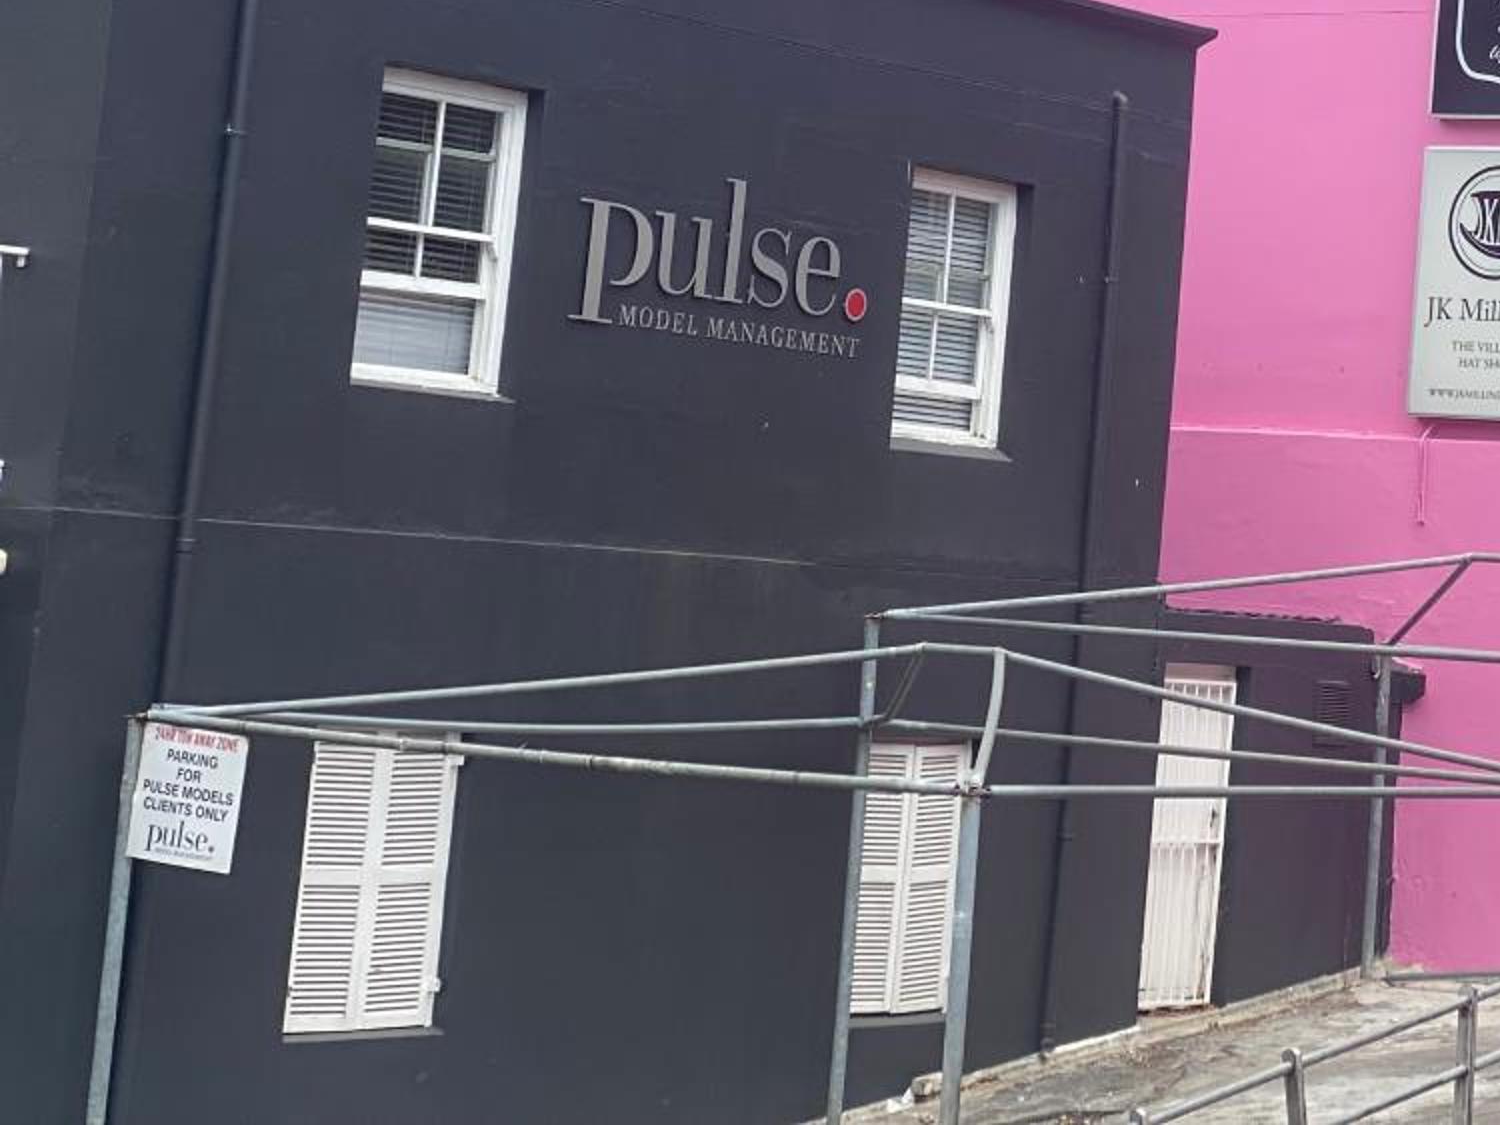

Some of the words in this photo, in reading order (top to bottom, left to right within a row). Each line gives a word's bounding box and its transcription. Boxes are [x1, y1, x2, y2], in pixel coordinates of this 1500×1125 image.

[1424, 296, 1453, 327] JK
[619, 304, 698, 337] MODEL
[705, 317, 861, 359] MANAGEMENT
[1451, 340, 1475, 352] THE
[1458, 358, 1480, 369] HAT
[167, 748, 219, 769] PARKING
[176, 767, 202, 784] FOR
[143, 778, 180, 797] PULSE
[182, 786, 234, 806] MODELS
[143, 796, 193, 816] CLIENTS
[195, 805, 229, 822] ONLY
